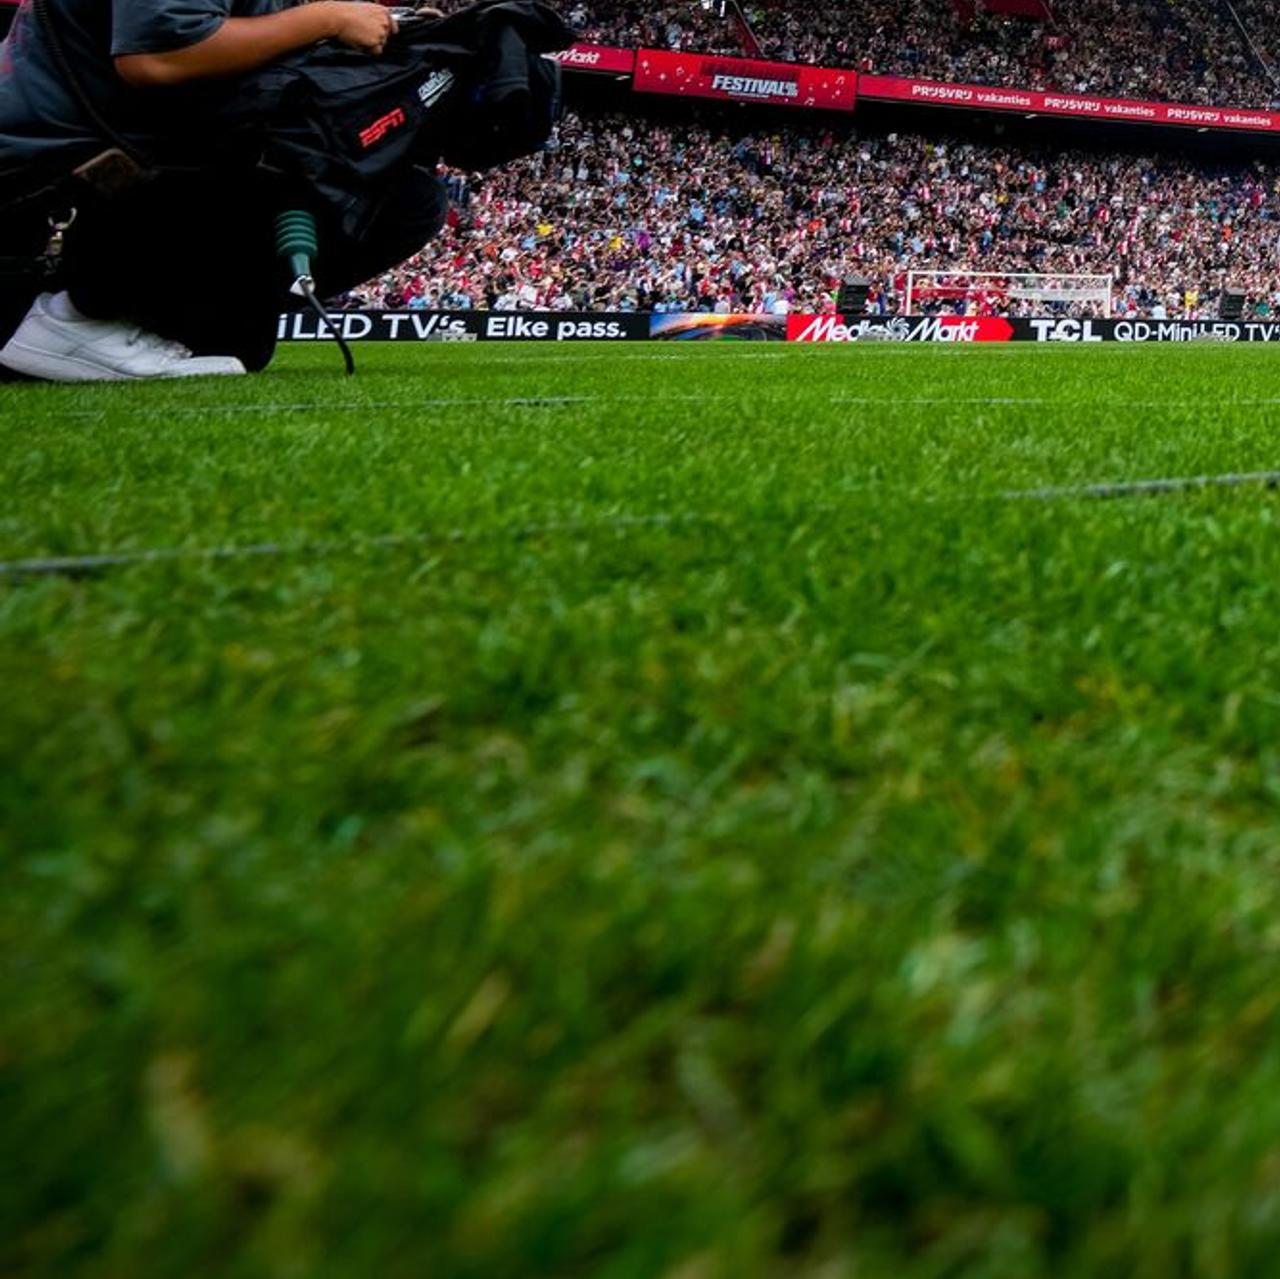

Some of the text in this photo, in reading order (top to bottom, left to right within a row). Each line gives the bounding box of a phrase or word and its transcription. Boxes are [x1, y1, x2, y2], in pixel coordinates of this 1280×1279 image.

[712, 74, 787, 96] FESTIVAL
[977, 92, 1031, 106] vakanties
[1104, 104, 1155, 117] vakanties
[1224, 114, 1272, 126] vakanties
[359, 107, 404, 147] ESPN
[486, 316, 549, 337] Elke
[556, 319, 627, 341] pass.
[1029, 320, 1102, 341] TCL
